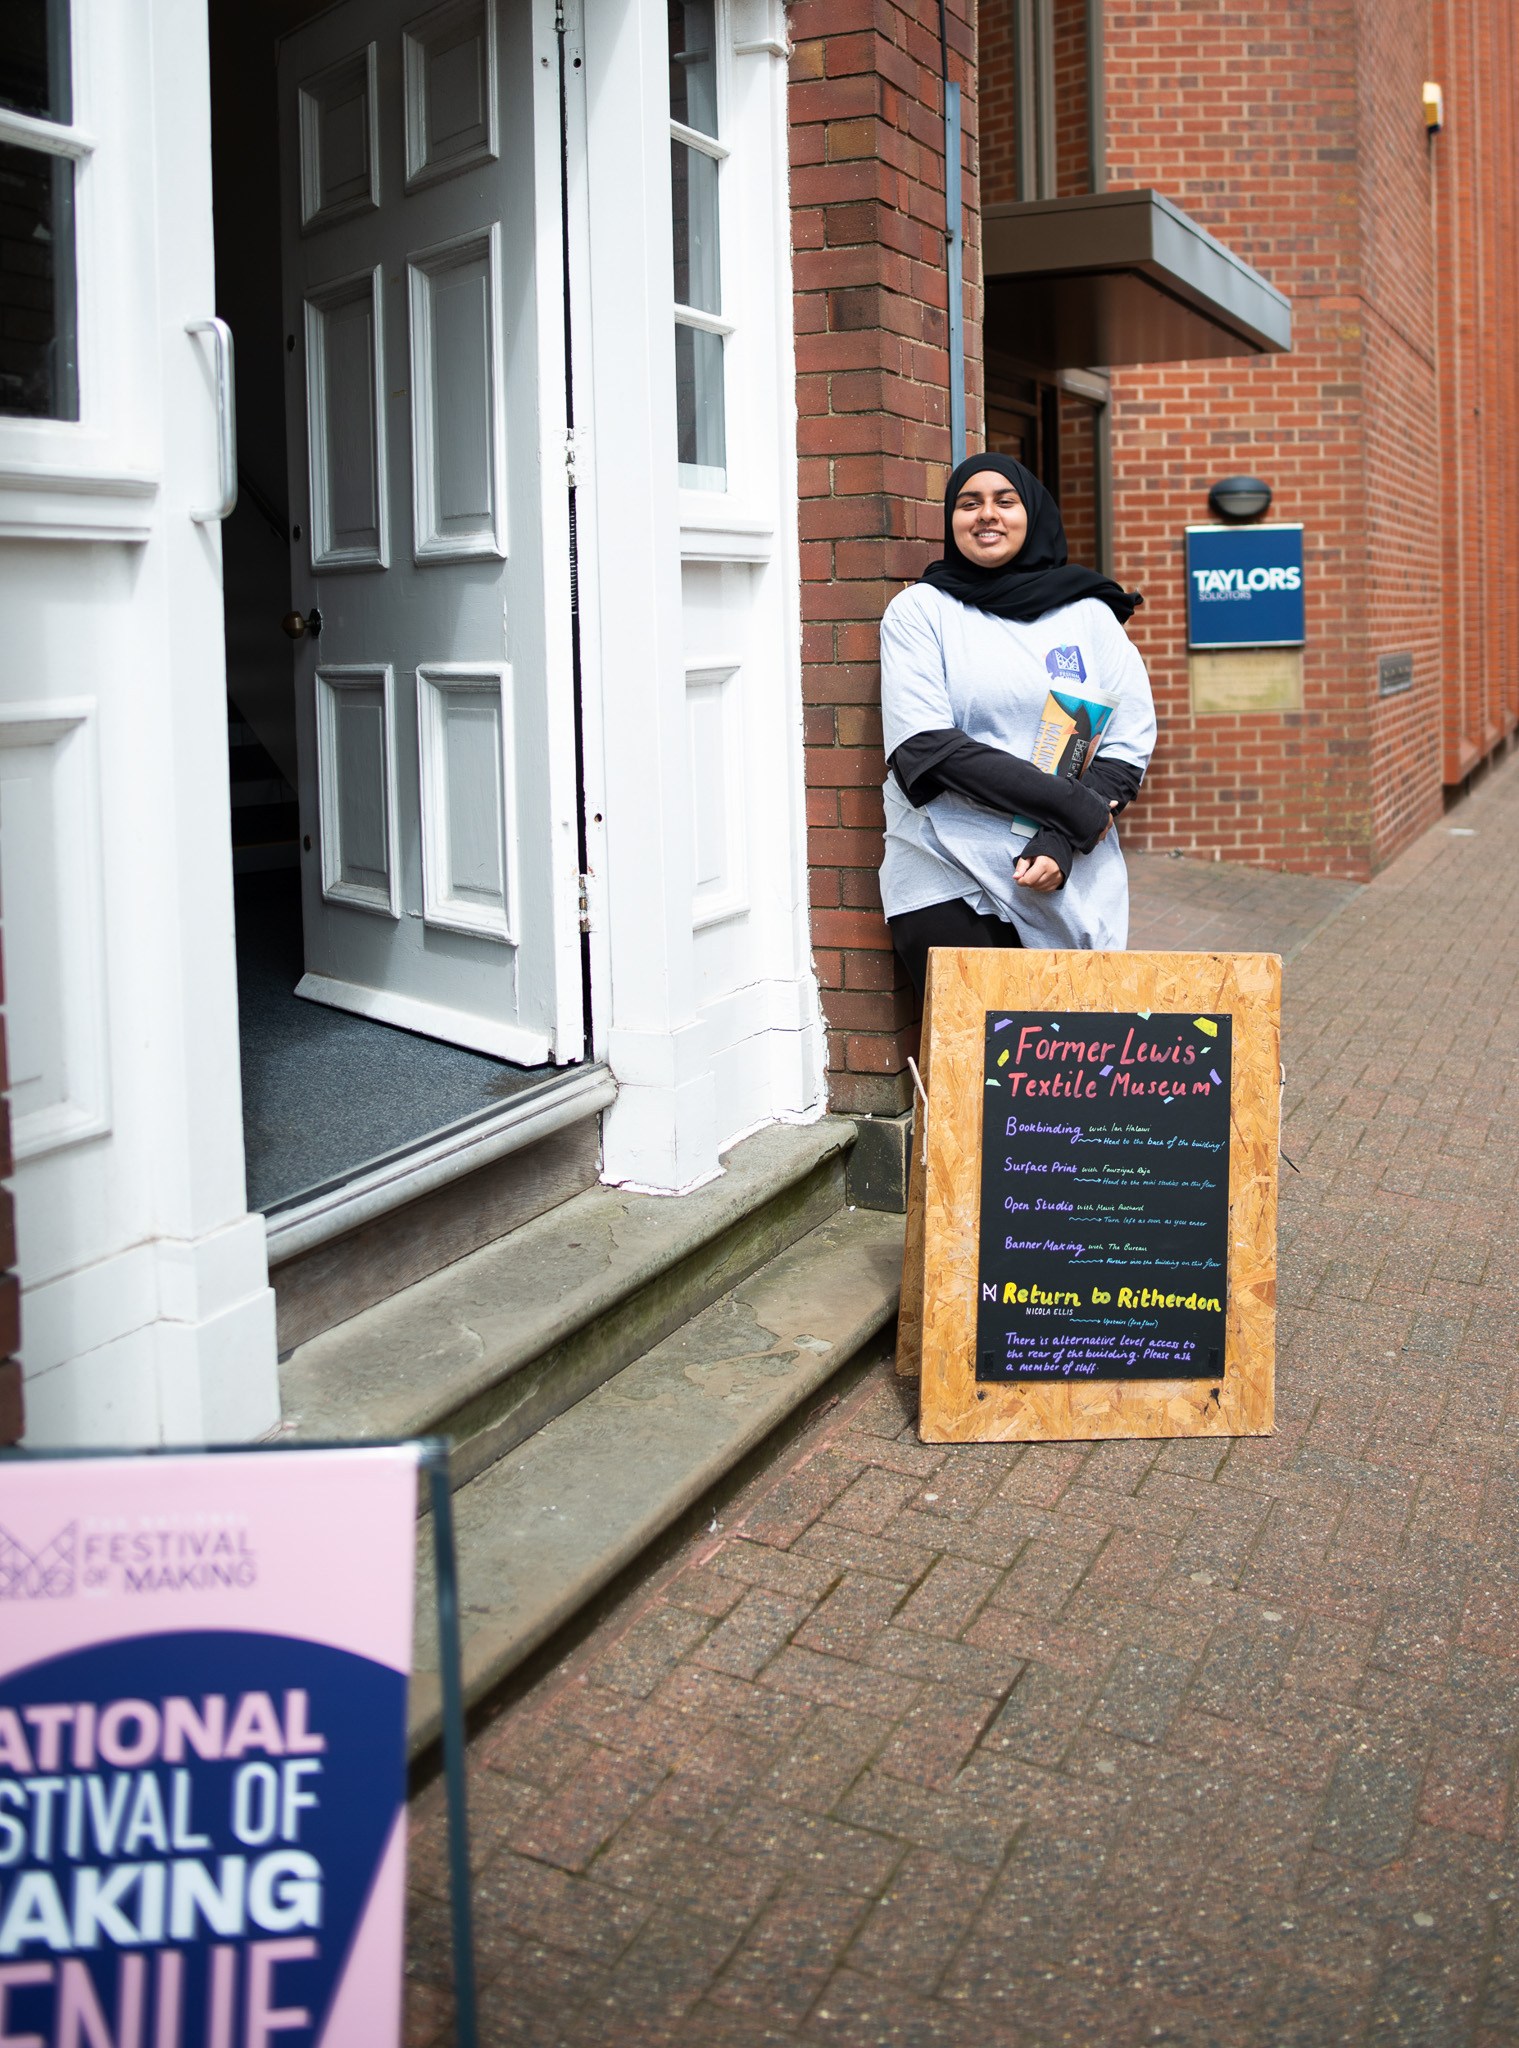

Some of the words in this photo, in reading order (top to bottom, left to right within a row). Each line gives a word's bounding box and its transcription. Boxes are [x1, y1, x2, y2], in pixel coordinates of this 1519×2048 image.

[1193, 566, 1301, 593] TAYLORS
[1199, 590, 1251, 601] SOLICITORS
[1036, 722, 1063, 774] MAKING
[1015, 1026, 1116, 1065] Former
[1120, 1027, 1196, 1065] Lewis
[1008, 1070, 1098, 1098] Textile
[1109, 1072, 1211, 1097] Museum
[1005, 1116, 1084, 1145] Bookbinding
[1089, 1124, 1107, 1132] with
[1103, 1137, 1120, 1145] Head
[1147, 1137, 1164, 1146] back
[1167, 1135, 1178, 1149] of
[1178, 1139, 1189, 1147] the
[1003, 1156, 1048, 1174] Surface
[1051, 1161, 1078, 1173] Print
[1102, 1177, 1119, 1185] Head
[1004, 1196, 1030, 1214] Open
[1034, 1198, 1074, 1211] Studio
[1103, 1216, 1120, 1224] Turn
[1123, 1217, 1136, 1225] left
[1005, 1236, 1042, 1250] Banner
[1042, 1239, 1086, 1257] Making
[1002, 1282, 1081, 1307] Return
[1091, 1287, 1111, 1304] to
[1117, 1287, 1222, 1312] Ritherdon
[1025, 1307, 1051, 1316] NICOLA
[1053, 1308, 1074, 1316] ELLIS
[1005, 1332, 1036, 1345] There
[1040, 1336, 1048, 1345] is
[1052, 1335, 1116, 1346] alternative
[1149, 1339, 1180, 1349] access
[1183, 1340, 1196, 1349] to
[1006, 1349, 1023, 1358] the
[1028, 1350, 1051, 1358] rear
[1052, 1348, 1066, 1363] of
[1067, 1349, 1084, 1358] the
[1143, 1348, 1170, 1360] Please
[1174, 1352, 1191, 1361] ask
[1006, 1363, 1013, 1371] a
[1019, 1362, 1059, 1371] member
[1062, 1360, 1074, 1375] of
[82, 1529, 256, 1563] FESTIVAL
[123, 1559, 257, 1593] MAKING
[233, 1757, 324, 1847] OF
